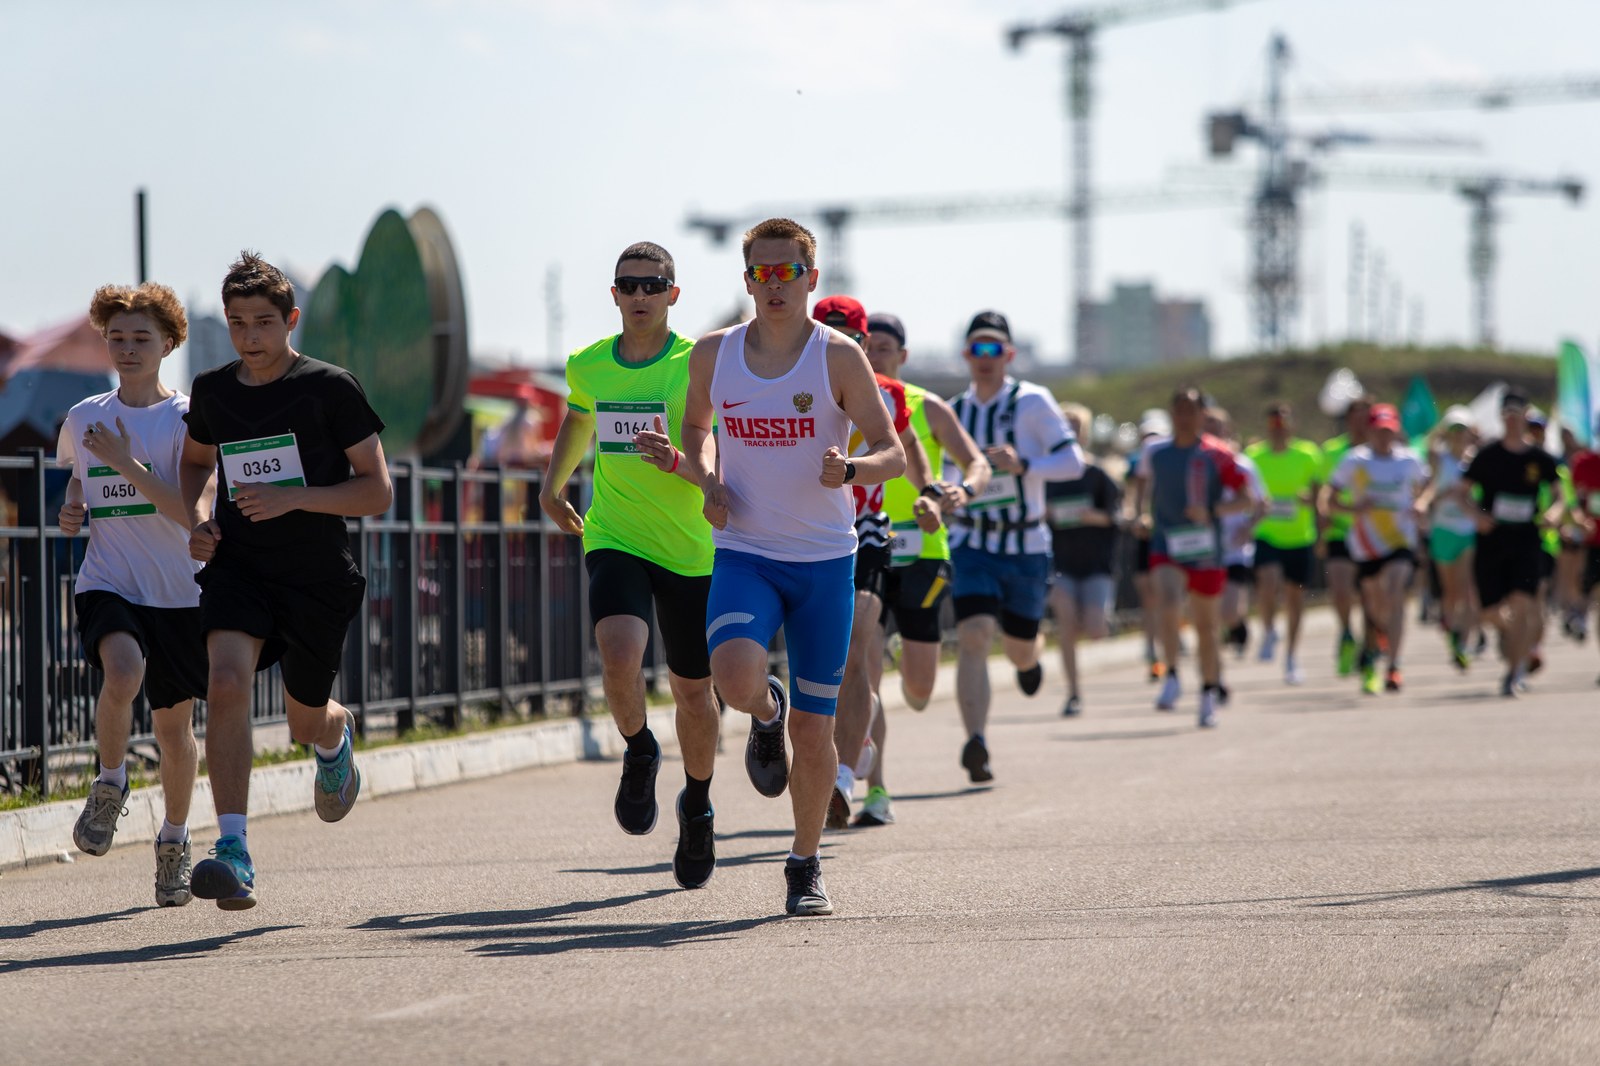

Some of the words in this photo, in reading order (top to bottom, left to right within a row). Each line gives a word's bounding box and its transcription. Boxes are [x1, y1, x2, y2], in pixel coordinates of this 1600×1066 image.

[723, 416, 815, 438] RUSSIA
[243, 458, 282, 477] 0363
[102, 483, 136, 499] 0450
